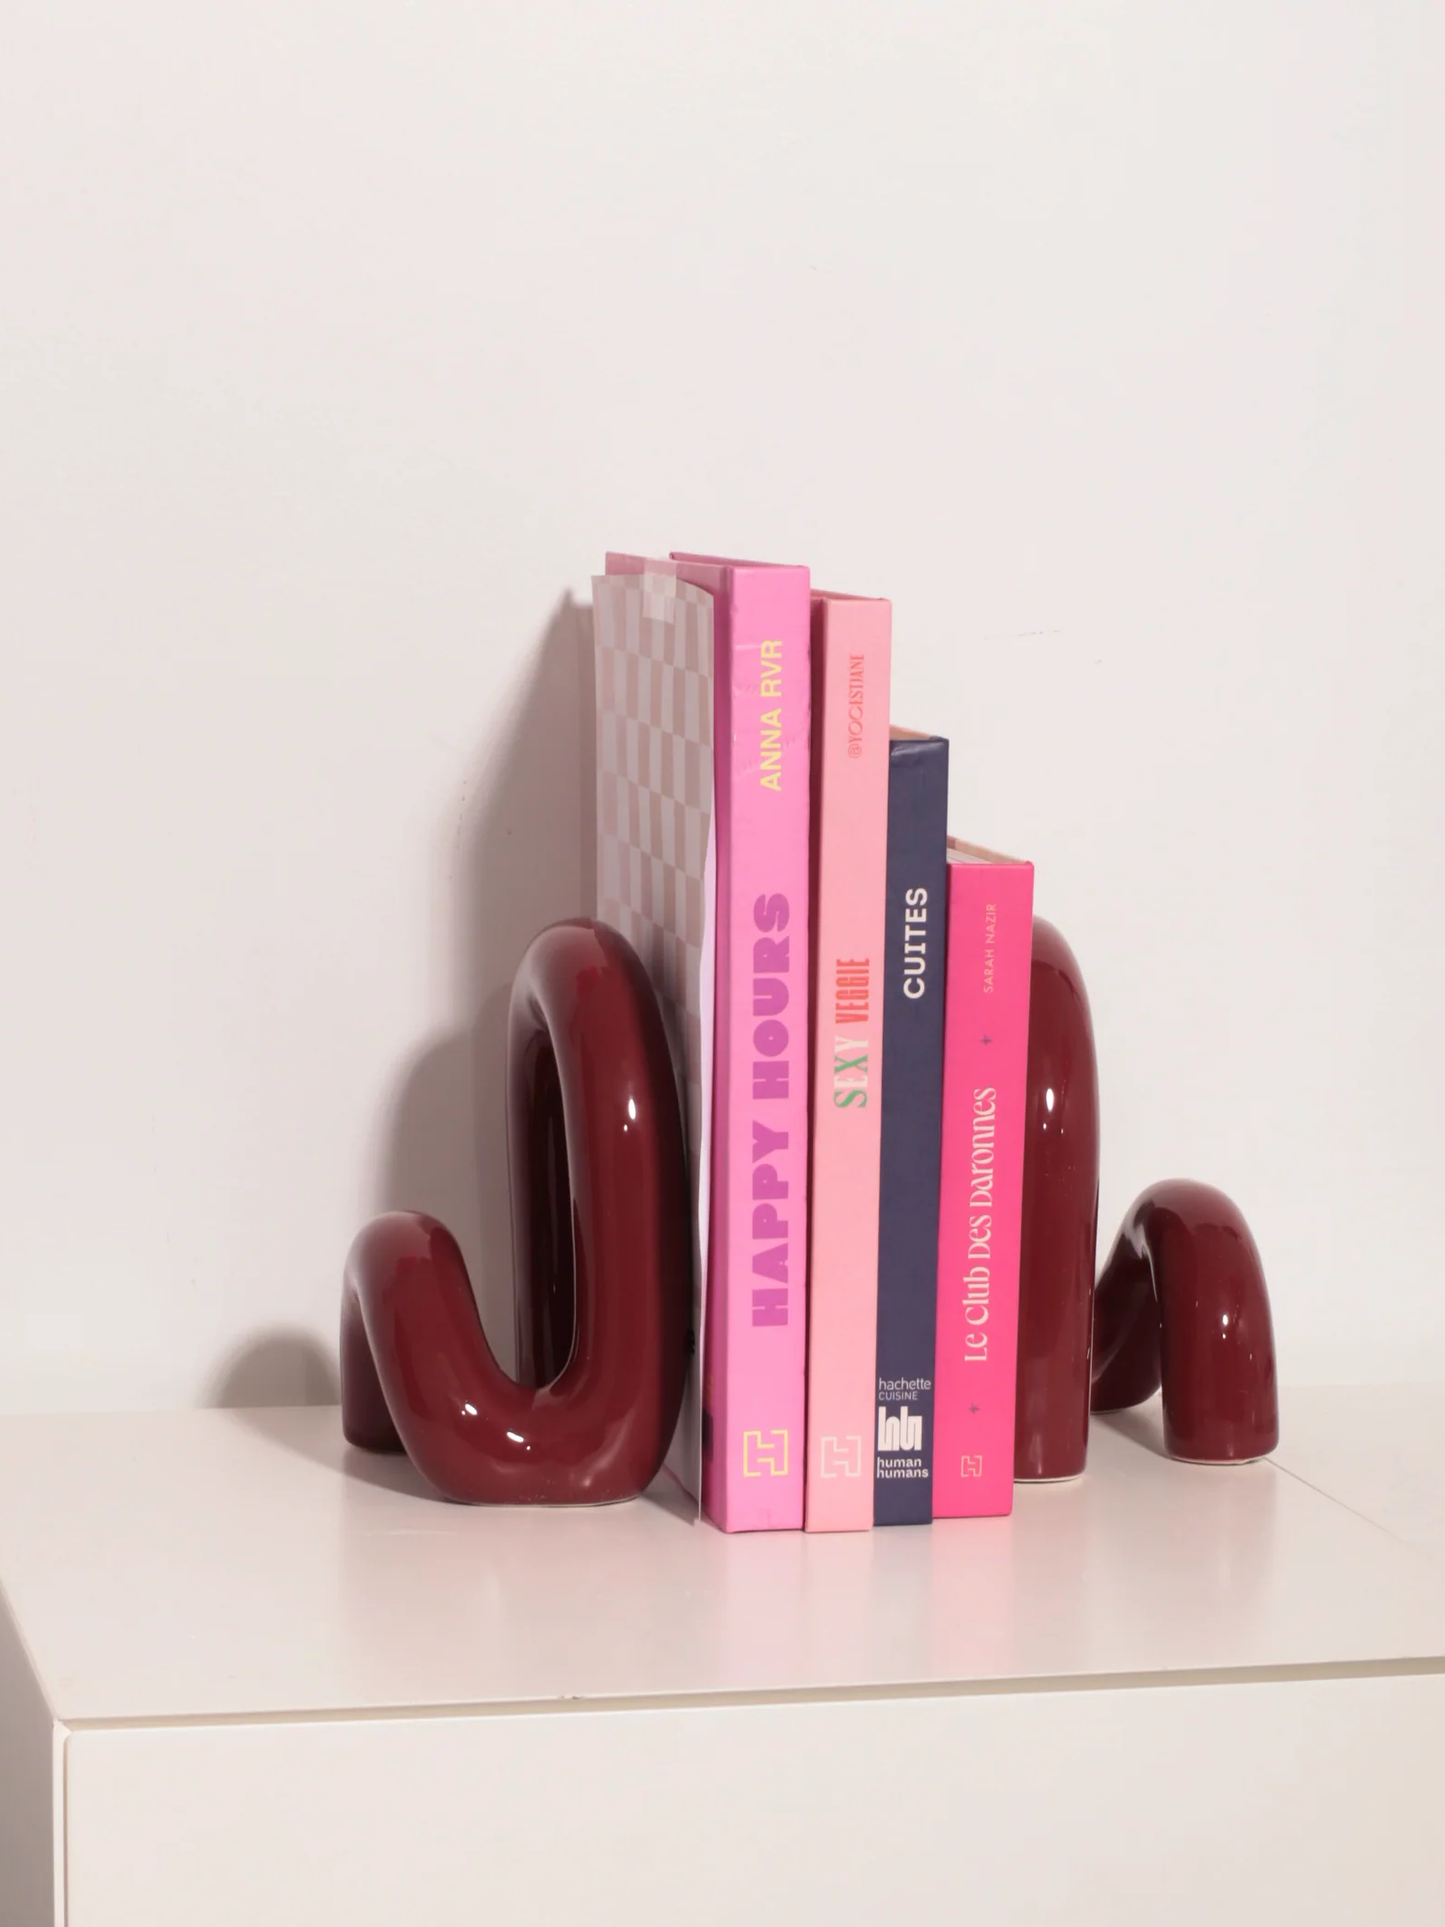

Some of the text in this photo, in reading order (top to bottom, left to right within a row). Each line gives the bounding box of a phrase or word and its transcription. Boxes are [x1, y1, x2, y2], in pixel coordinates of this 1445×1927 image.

[759, 639, 783, 791] ANNA RVR
[903, 888, 928, 999] CUITES
[983, 903, 996, 993] SARAH NAZIR
[833, 957, 870, 1109] SEXY VEGGIE
[752, 893, 790, 1327] HAPPY HOURS
[962, 1265, 990, 1327] Club
[878, 1377, 931, 1391] hachette
[878, 1391, 918, 1401] CUISINE
[877, 1456, 922, 1468] human
[877, 1467, 929, 1478] humans
